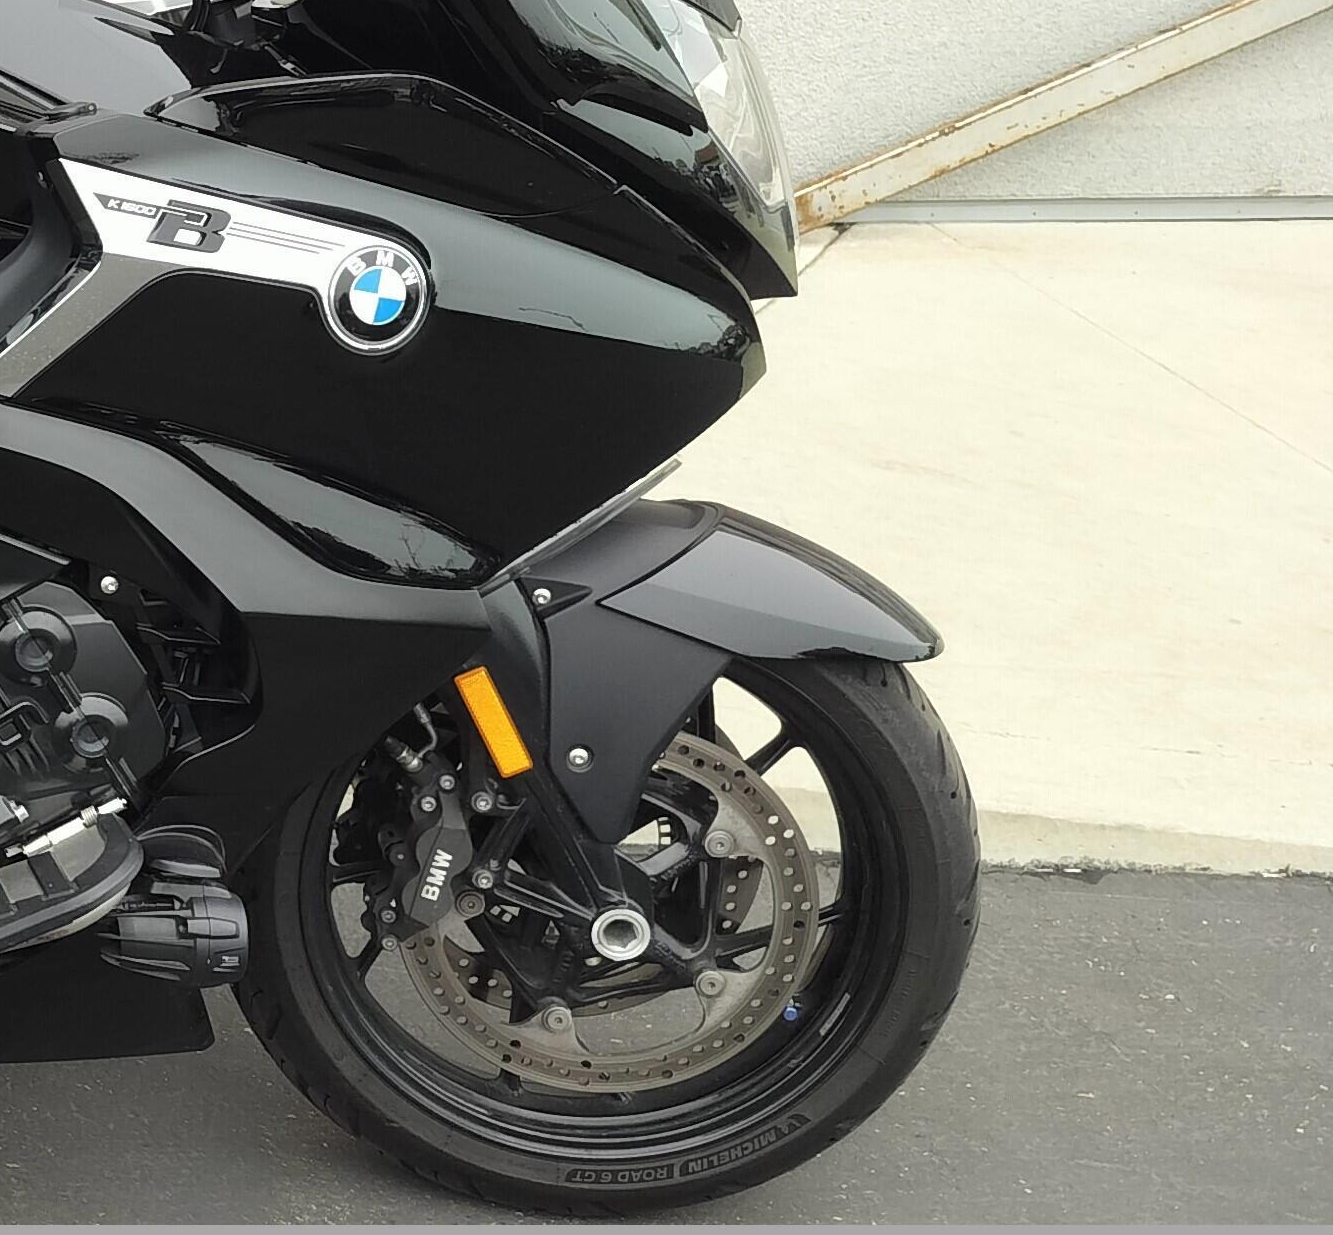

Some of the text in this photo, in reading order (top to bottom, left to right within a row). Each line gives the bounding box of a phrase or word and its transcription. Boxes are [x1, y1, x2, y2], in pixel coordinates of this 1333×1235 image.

[107, 198, 232, 254] K 1600 B
[346, 250, 419, 286] BMW
[420, 848, 453, 902] BMW
[571, 1127, 778, 1183] MICHELIN ROAD 6 GT
